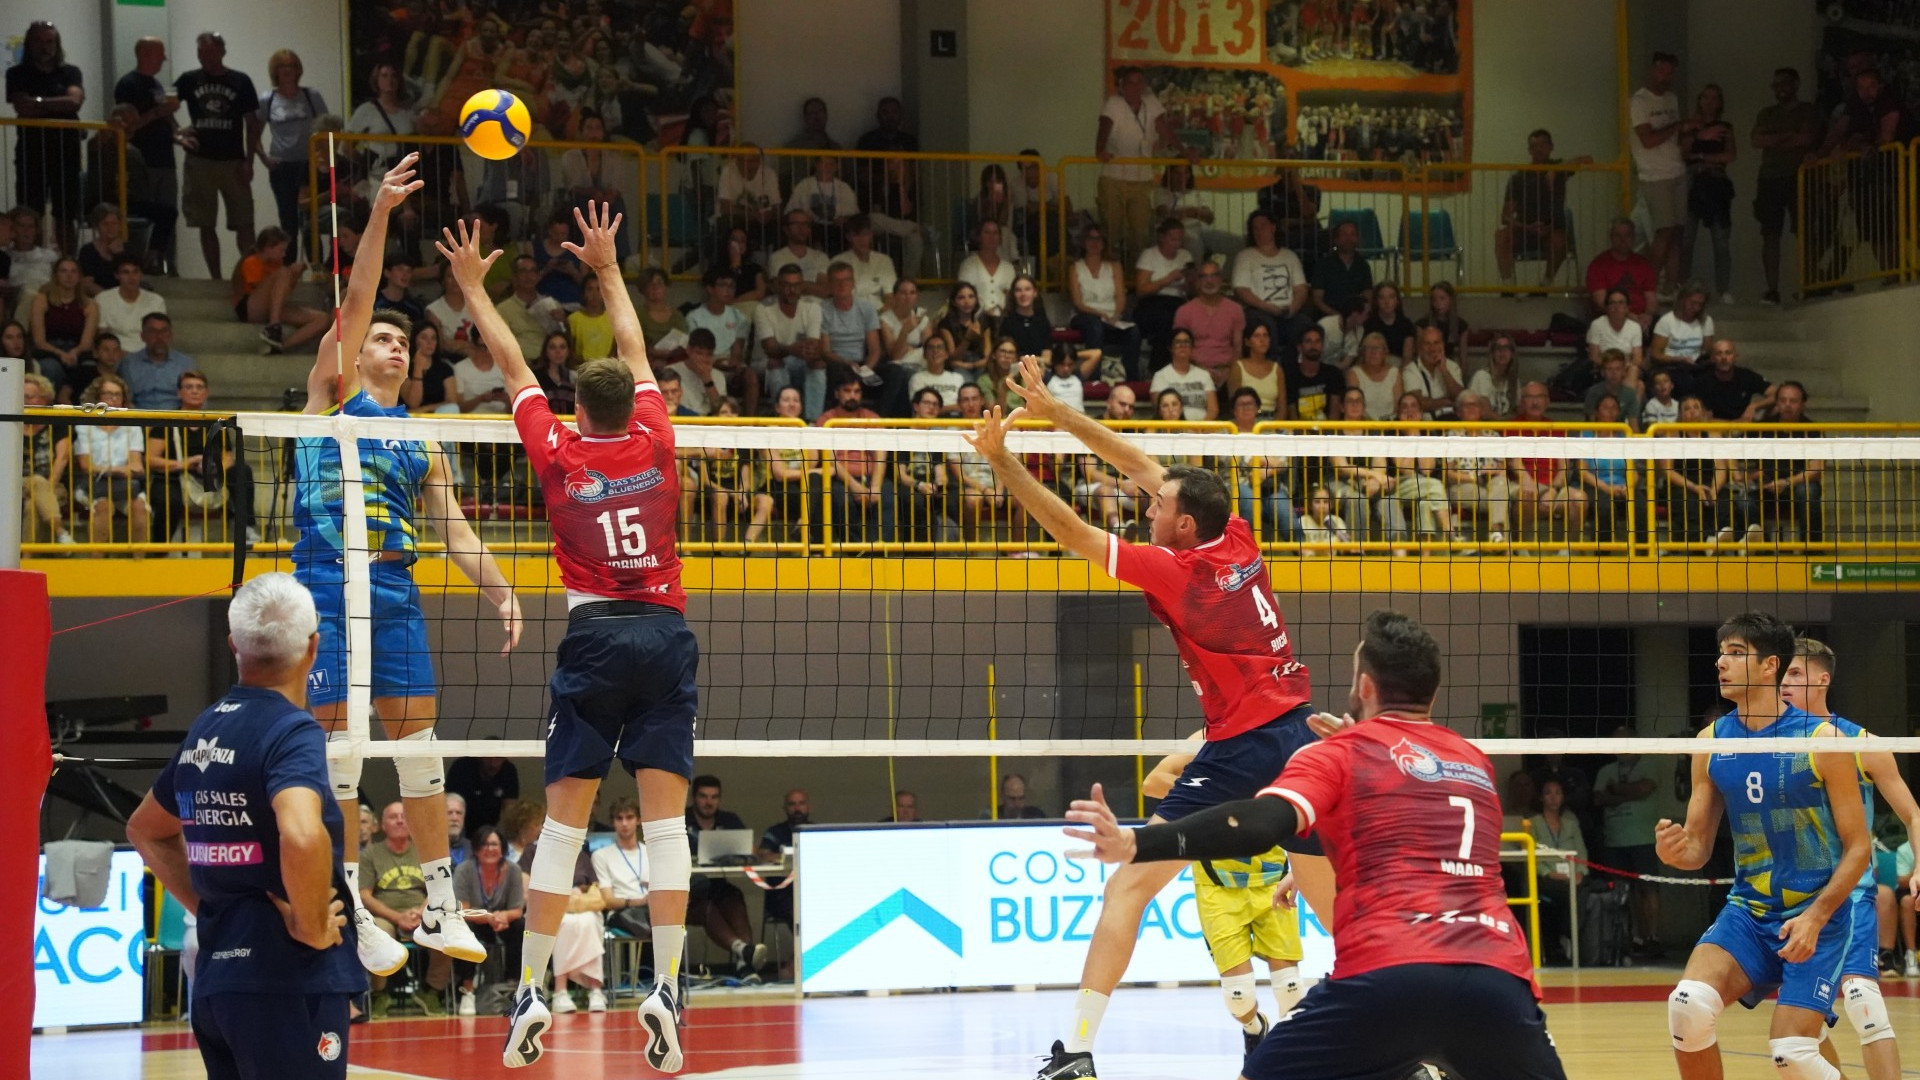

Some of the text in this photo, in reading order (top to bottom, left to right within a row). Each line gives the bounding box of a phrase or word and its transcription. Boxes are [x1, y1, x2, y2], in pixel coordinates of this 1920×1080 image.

[1117, 0, 1255, 56] 2013
[937, 35, 949, 52] L
[607, 474, 662, 496] BLUENERGY
[608, 469, 660, 489] GAS SALES
[596, 506, 647, 558] 15
[1251, 584, 1278, 629] 4
[210, 790, 248, 807] SALES
[1745, 771, 1764, 804] 8
[195, 809, 254, 826] ENERGIA
[1448, 795, 1475, 860] 7
